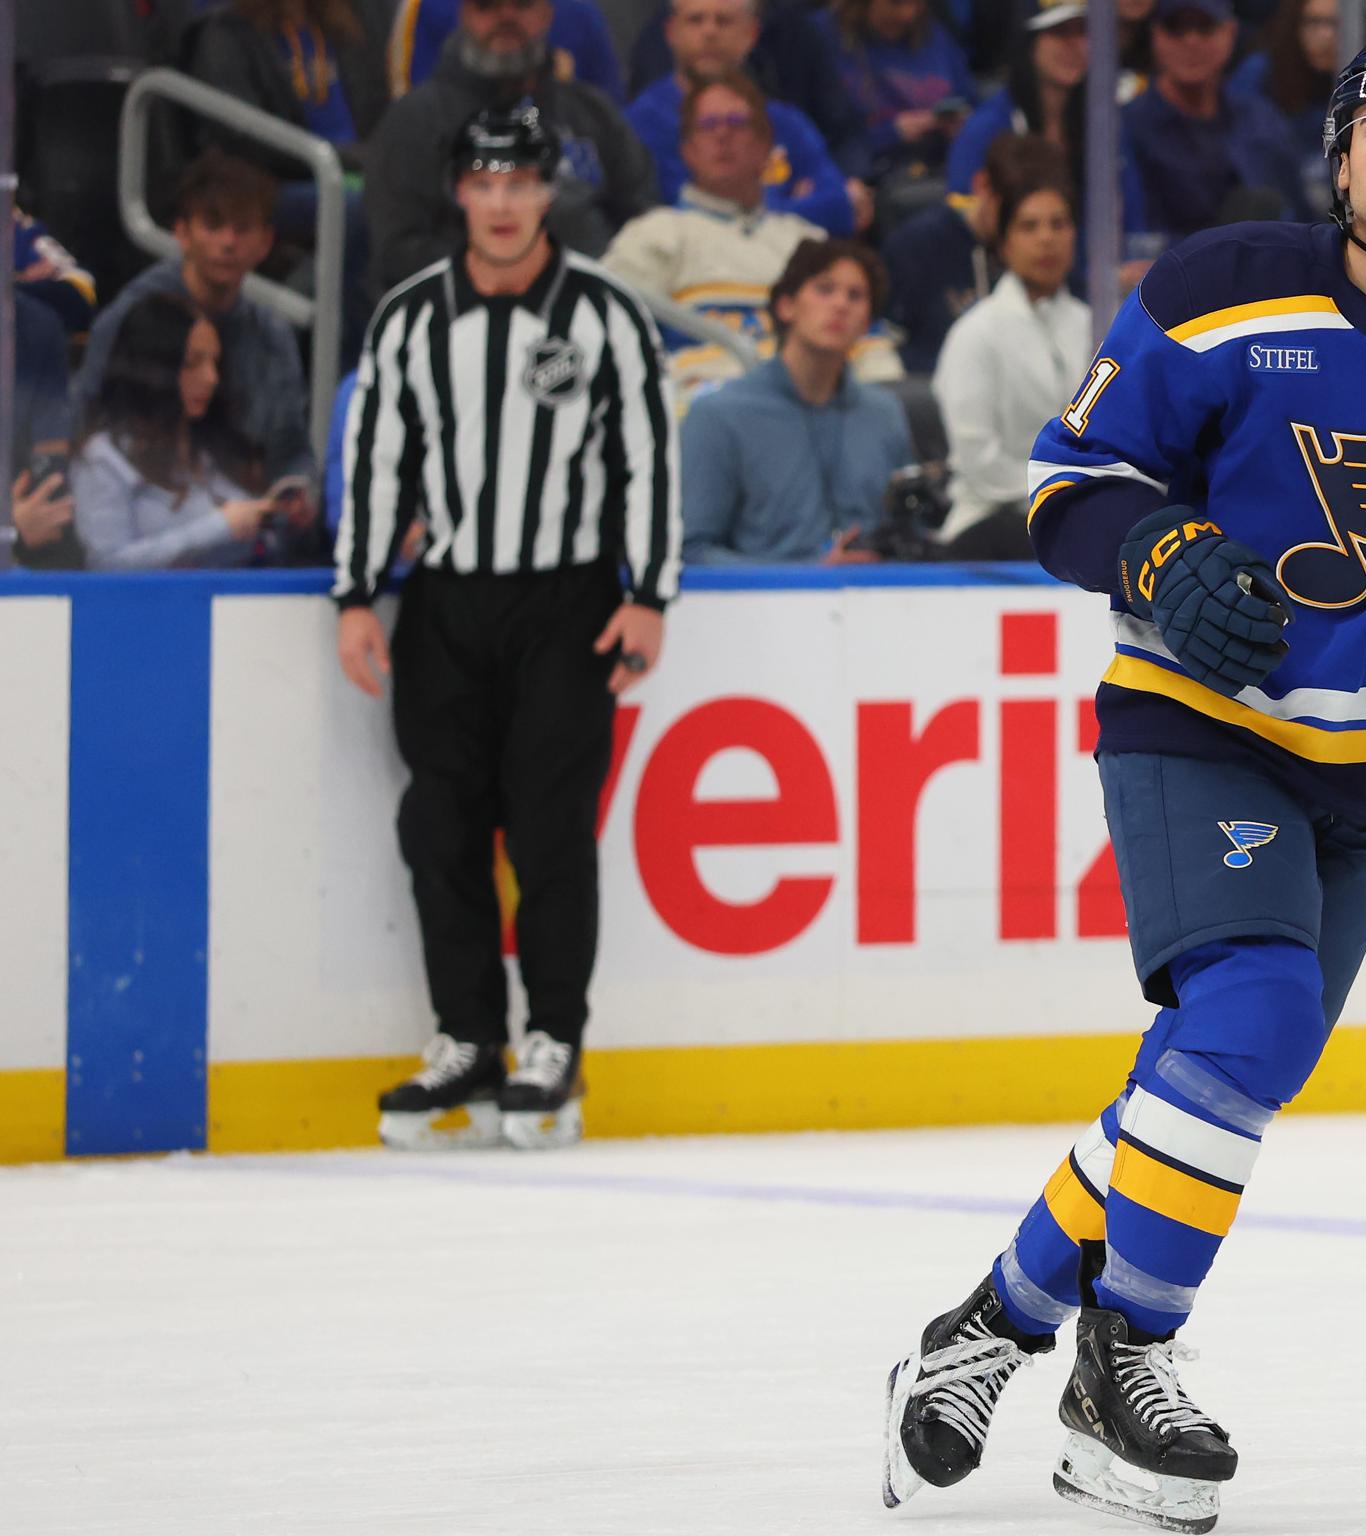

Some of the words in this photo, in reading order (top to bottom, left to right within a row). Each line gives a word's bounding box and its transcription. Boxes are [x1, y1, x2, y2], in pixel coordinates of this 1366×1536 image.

[1249, 345, 1318, 370] STIFEL
[1121, 559, 1133, 602] SNUGGERUD
[1138, 521, 1222, 601] CCM
